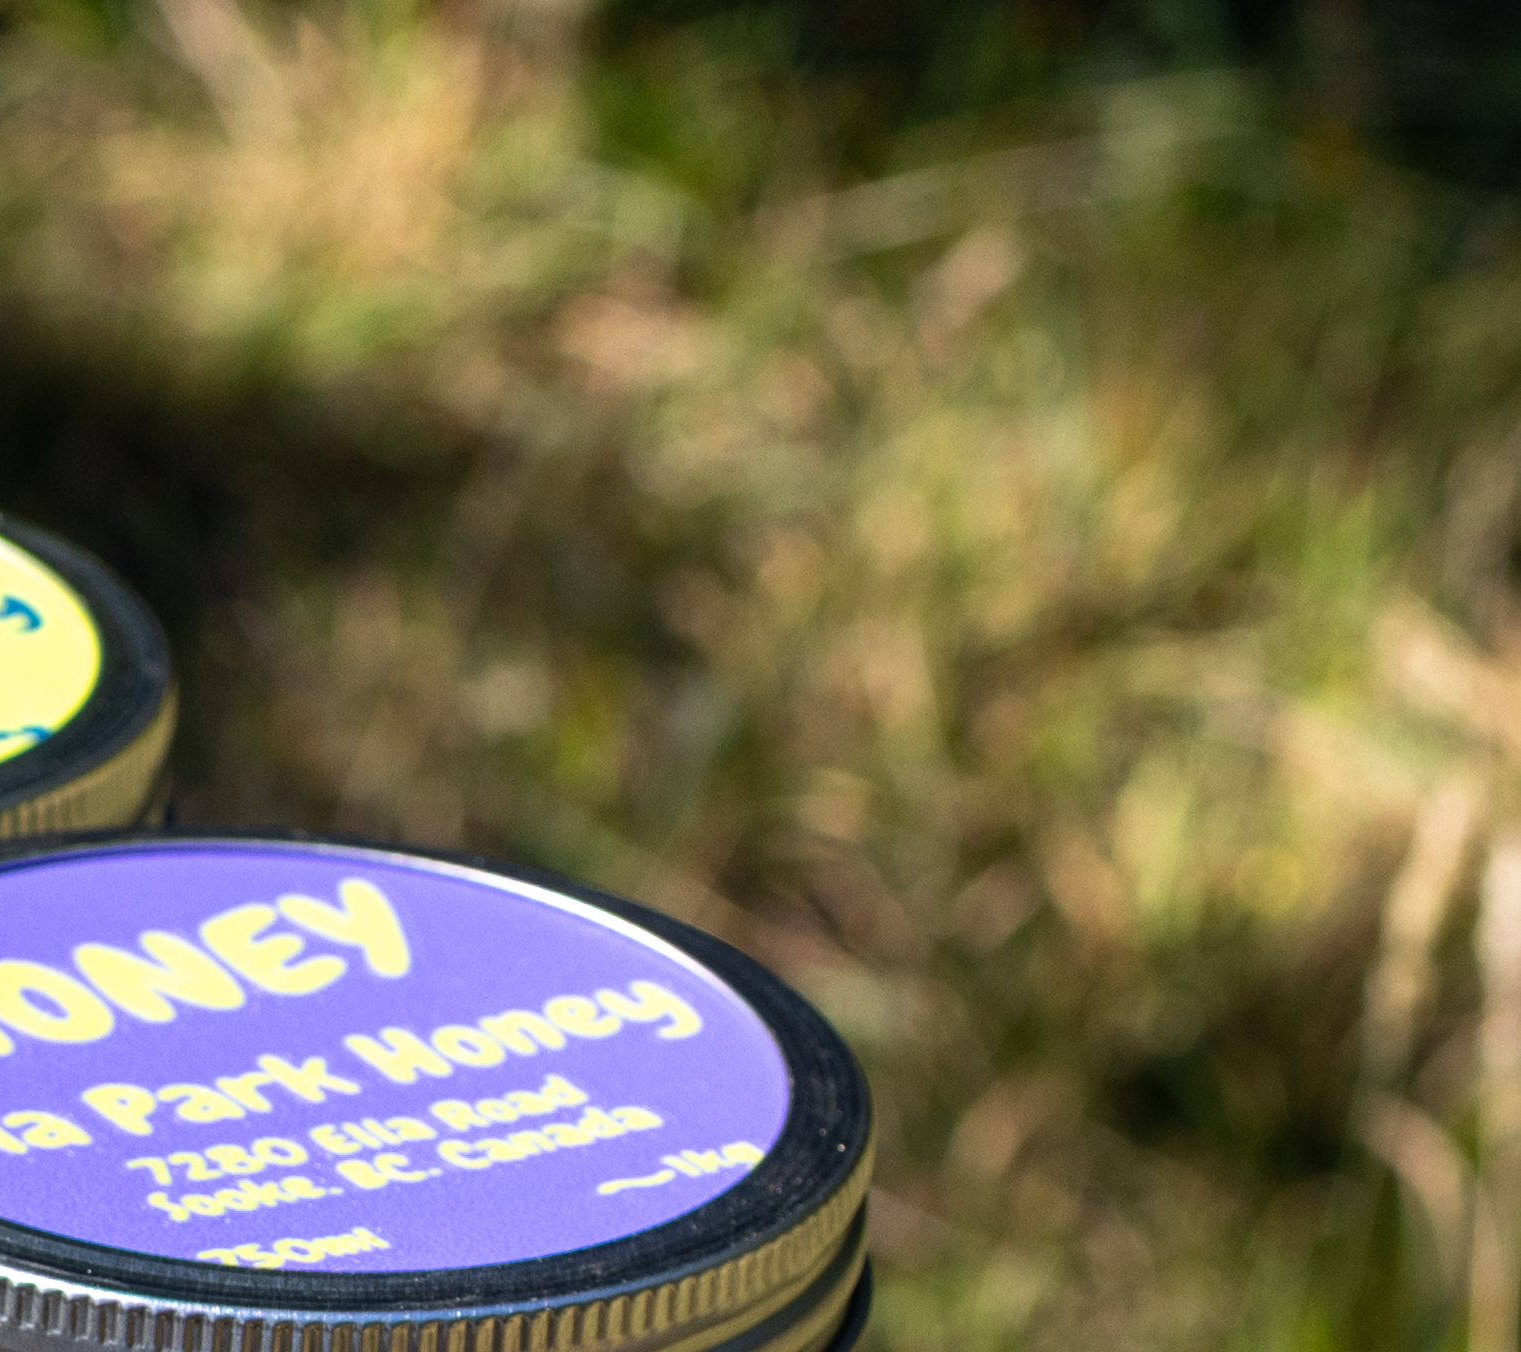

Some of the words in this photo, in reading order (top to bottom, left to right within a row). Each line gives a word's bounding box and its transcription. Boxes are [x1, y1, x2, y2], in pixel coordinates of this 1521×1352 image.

[81, 1053, 360, 1136] Park
[342, 980, 701, 1088] Honey
[126, 1137, 309, 1186] 7280
[310, 1115, 437, 1158] Ella
[430, 1073, 590, 1132] Road
[437, 1105, 663, 1170] Canada
